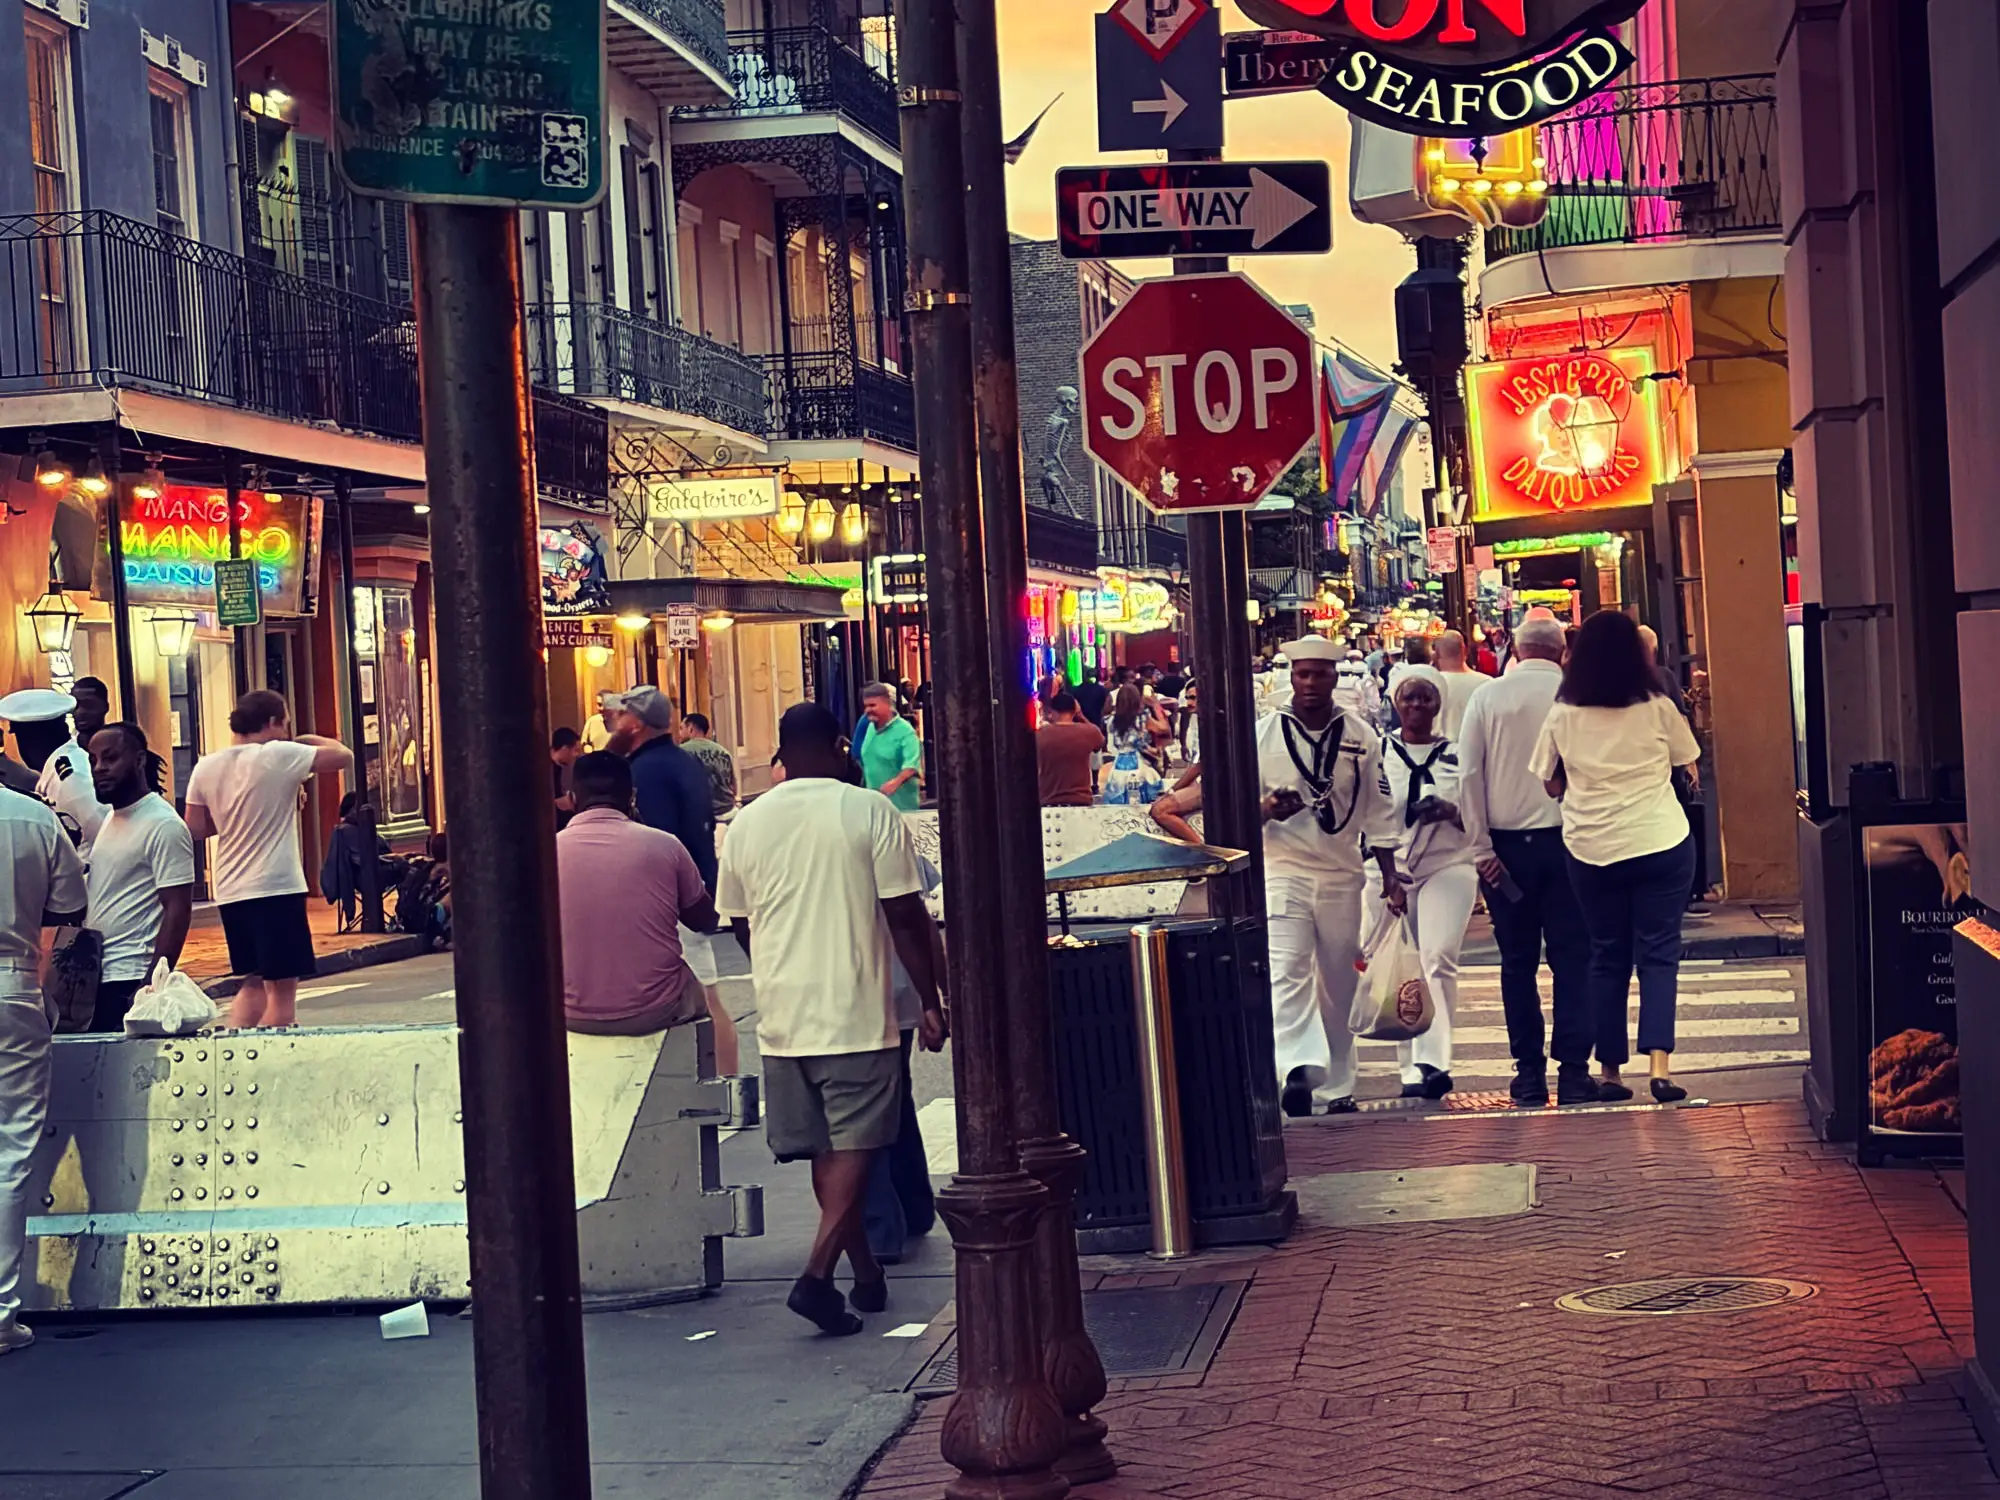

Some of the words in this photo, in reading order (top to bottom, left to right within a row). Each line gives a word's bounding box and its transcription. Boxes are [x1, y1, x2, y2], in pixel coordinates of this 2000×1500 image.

[448, 0, 552, 31] DRINKS
[413, 26, 473, 60] MAY
[432, 65, 545, 105] LASTIC
[1336, 36, 1619, 125] SEAFOOD
[1088, 195, 1163, 231] ONE
[1176, 191, 1250, 226] WAY
[1101, 347, 1298, 440] STOP
[655, 486, 769, 513] Galatoire's
[107, 521, 291, 560] MANGO
[124, 560, 279, 588] DAIQUS
[544, 633, 567, 646] ANS
[568, 634, 612, 648] CUISINE
[545, 621, 581, 634] ENTIC
[1927, 973, 1955, 985] Grea
